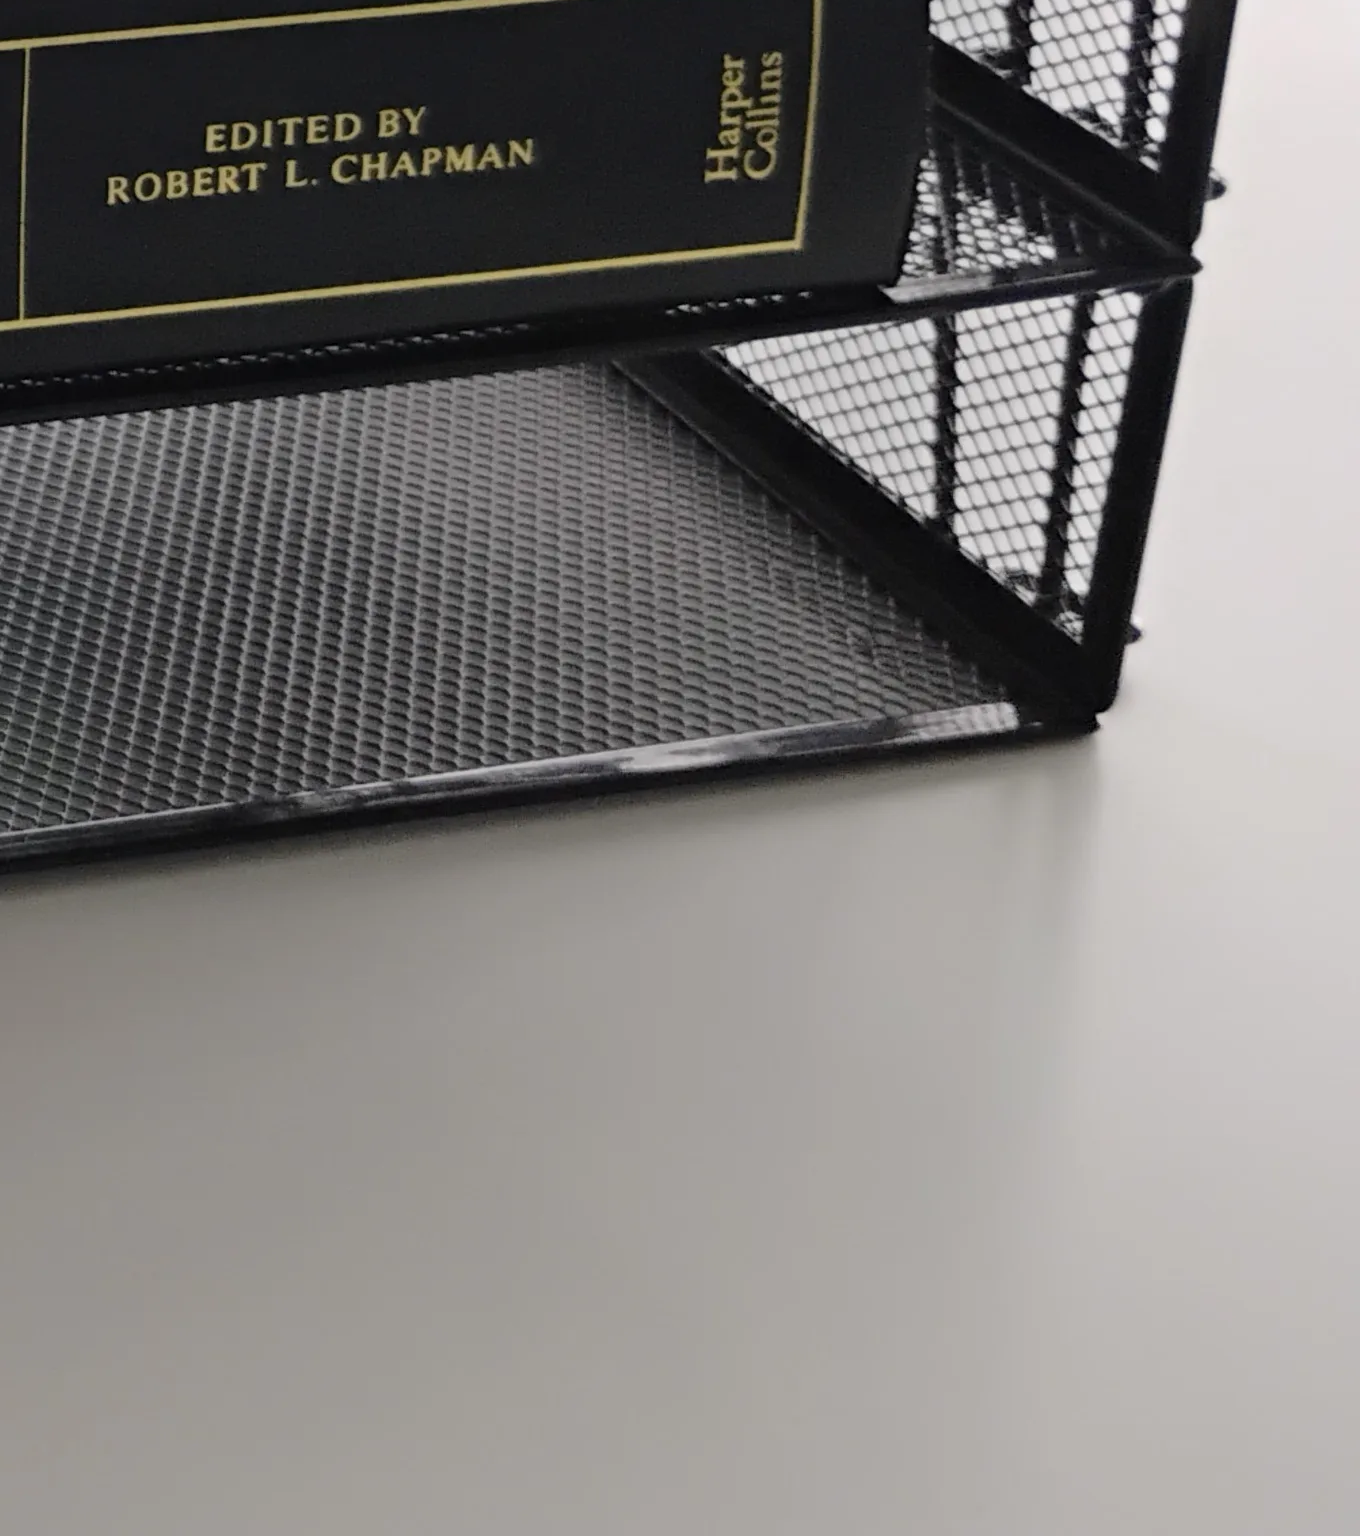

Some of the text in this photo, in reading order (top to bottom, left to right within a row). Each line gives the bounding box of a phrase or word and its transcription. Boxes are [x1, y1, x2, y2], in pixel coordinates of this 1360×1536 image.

[204, 105, 428, 154] EDITED BY
[703, 53, 754, 184] Harper
[743, 50, 784, 180] Collins
[106, 137, 534, 207] ROBERT L. CHAPMAN
